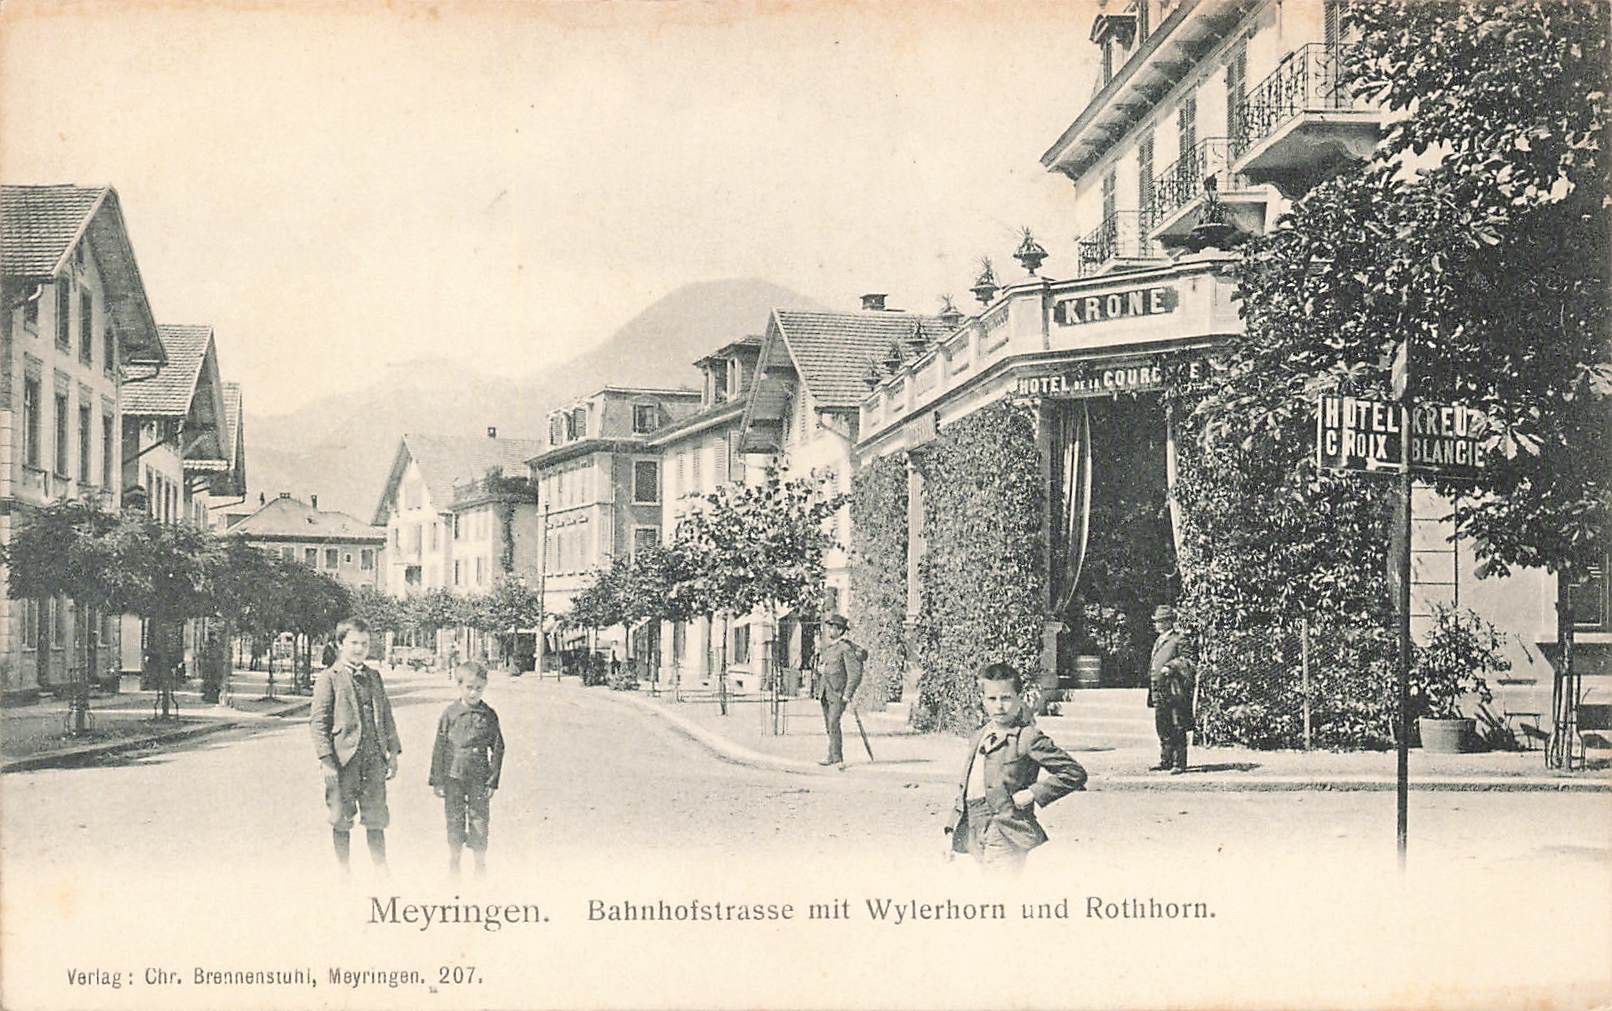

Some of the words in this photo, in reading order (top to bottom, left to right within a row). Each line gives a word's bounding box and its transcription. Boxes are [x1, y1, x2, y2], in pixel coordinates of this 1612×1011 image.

[1064, 287, 1166, 325] KRONE
[1018, 375, 1070, 395] HOTEL
[1325, 396, 1399, 433] HOTEL
[1325, 429, 1388, 460] CROIX
